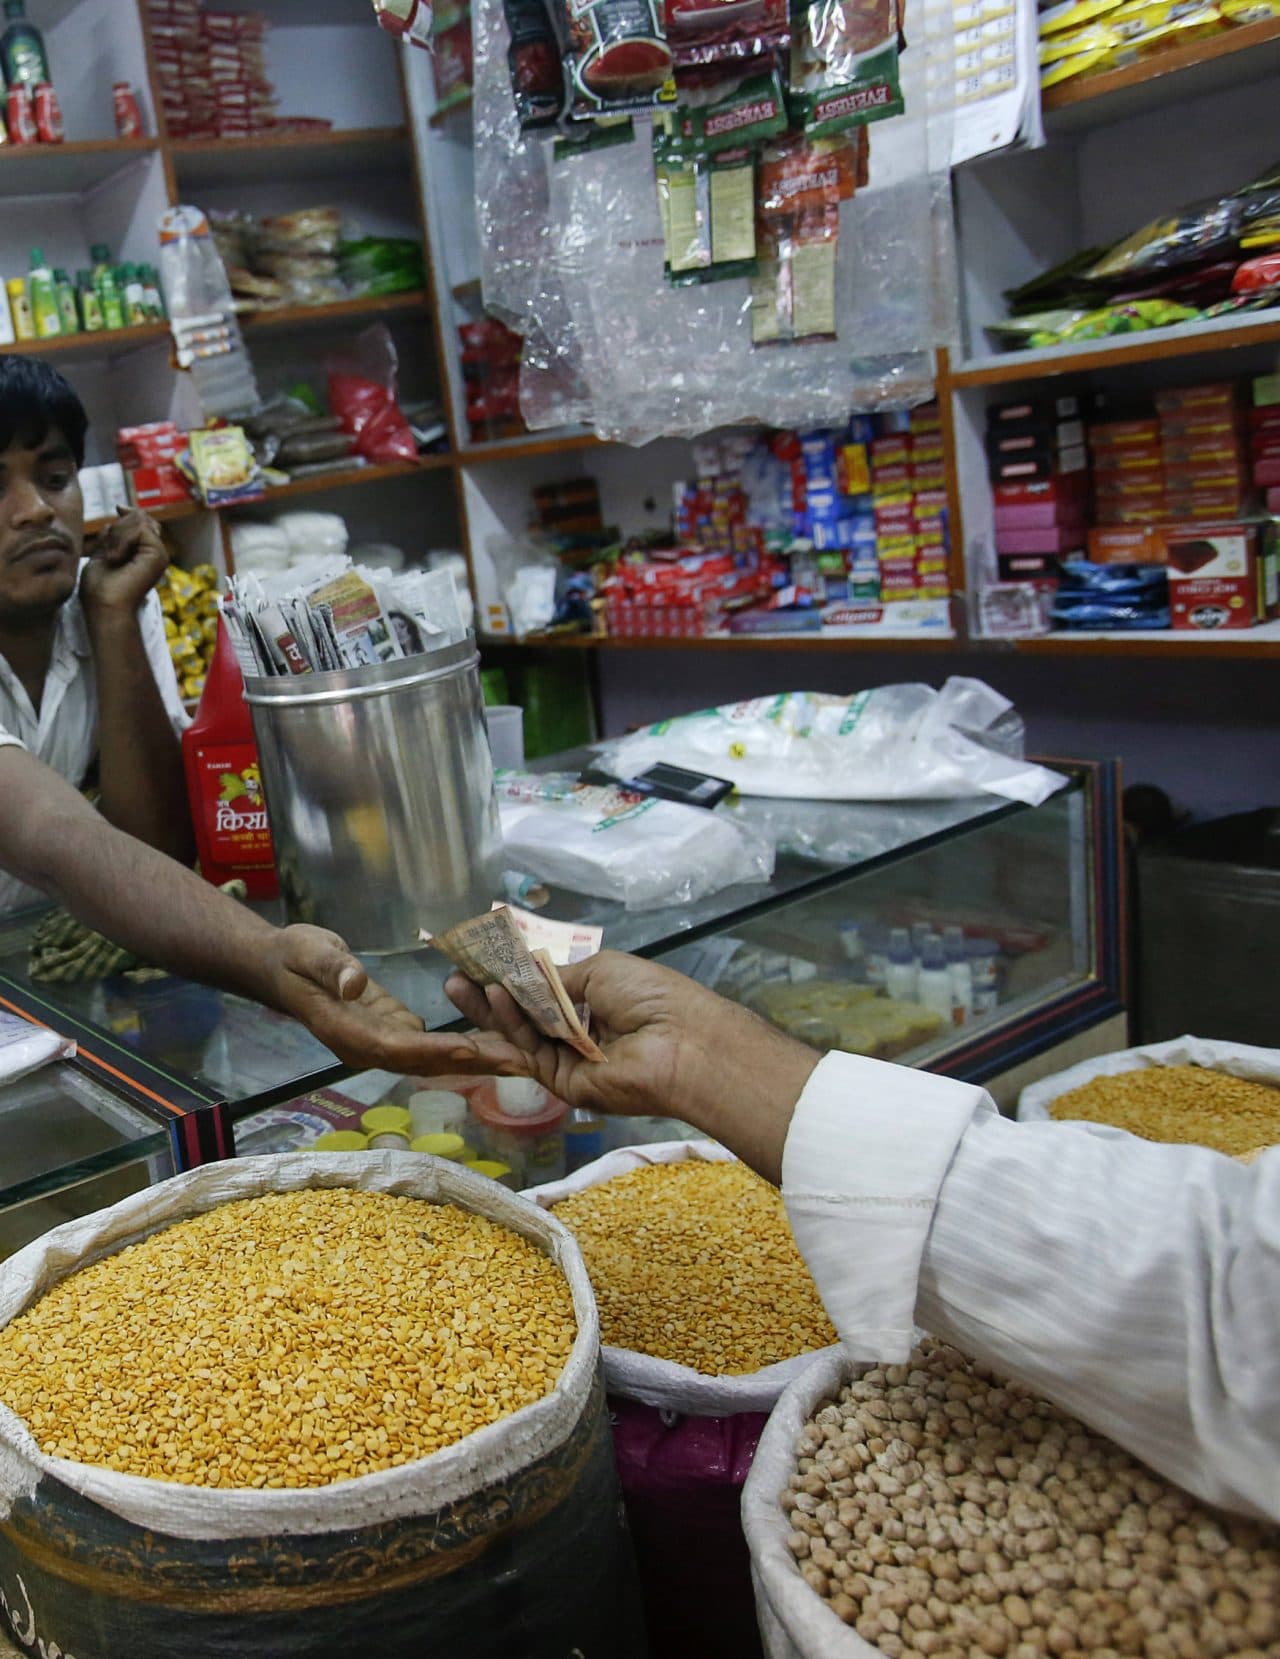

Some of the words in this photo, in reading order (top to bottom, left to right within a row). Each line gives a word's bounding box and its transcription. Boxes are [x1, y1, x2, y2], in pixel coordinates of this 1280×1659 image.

[816, 88, 889, 121] EVEREST
[706, 103, 775, 135] EVEREST
[215, 807, 269, 832] किसा
[309, 1093, 357, 1118] Sonata
